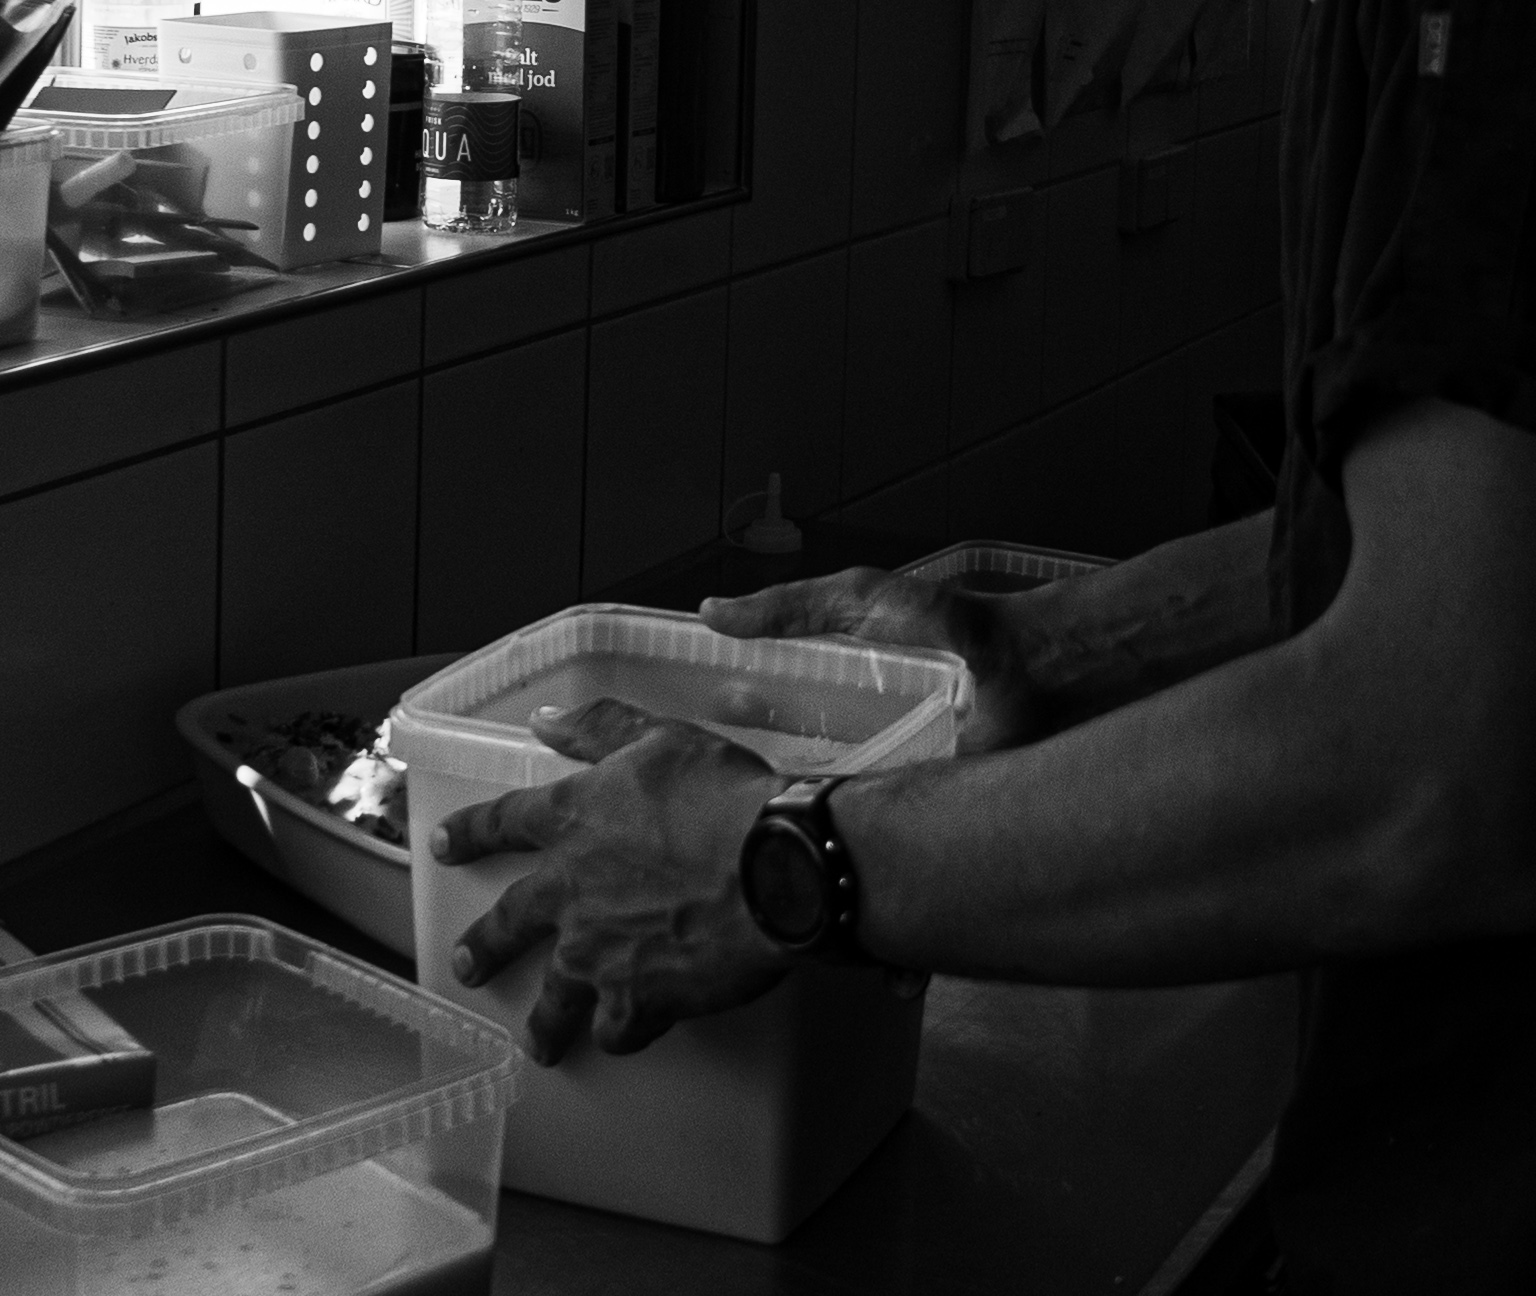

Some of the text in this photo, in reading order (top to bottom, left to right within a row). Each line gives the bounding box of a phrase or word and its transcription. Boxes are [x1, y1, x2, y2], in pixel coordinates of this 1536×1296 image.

[124, 54, 158, 64] Hverd
[527, 69, 555, 90] jod
[426, 115, 442, 125] FRISK
[423, 129, 471, 161] QUA
